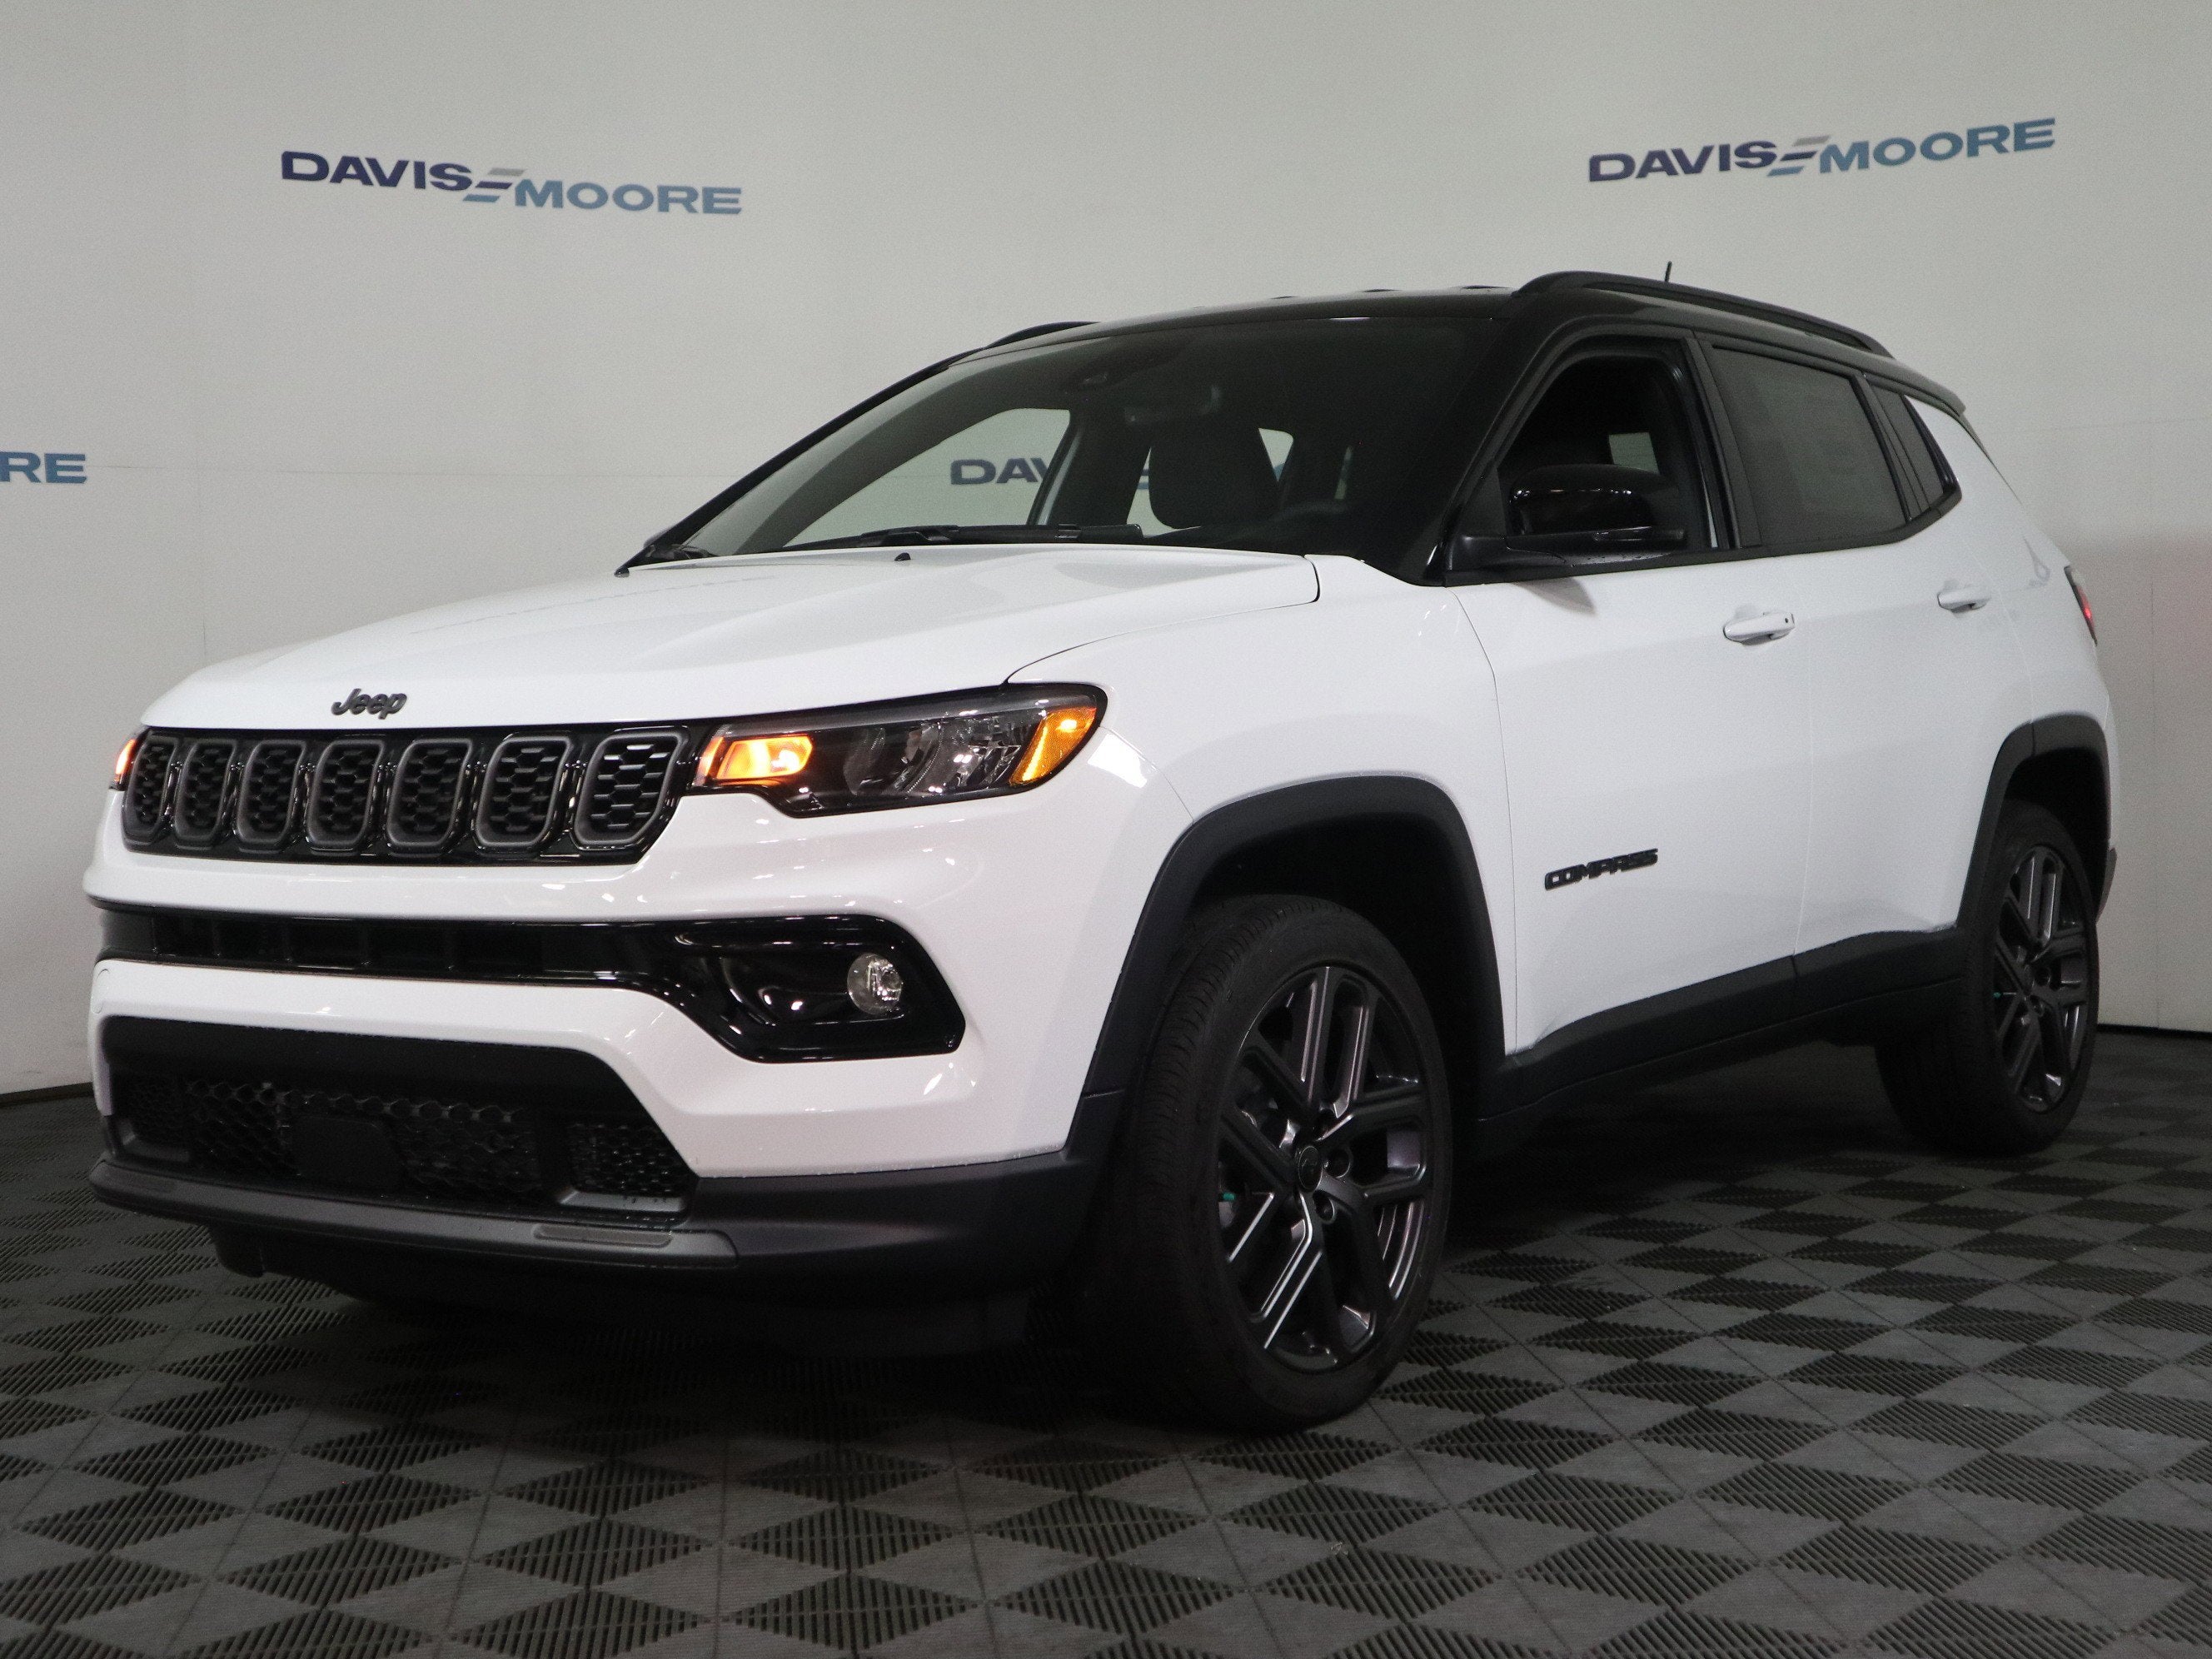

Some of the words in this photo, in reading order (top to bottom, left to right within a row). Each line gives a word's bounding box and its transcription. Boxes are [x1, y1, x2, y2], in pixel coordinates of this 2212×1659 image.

[1589, 141, 1777, 182] DAVIS
[1820, 118, 2055, 174] MOORE
[281, 151, 472, 192] DAVIS
[514, 178, 742, 215] MOORE
[331, 688, 407, 720] Jeep
[1544, 848, 1659, 890] COMPASS
